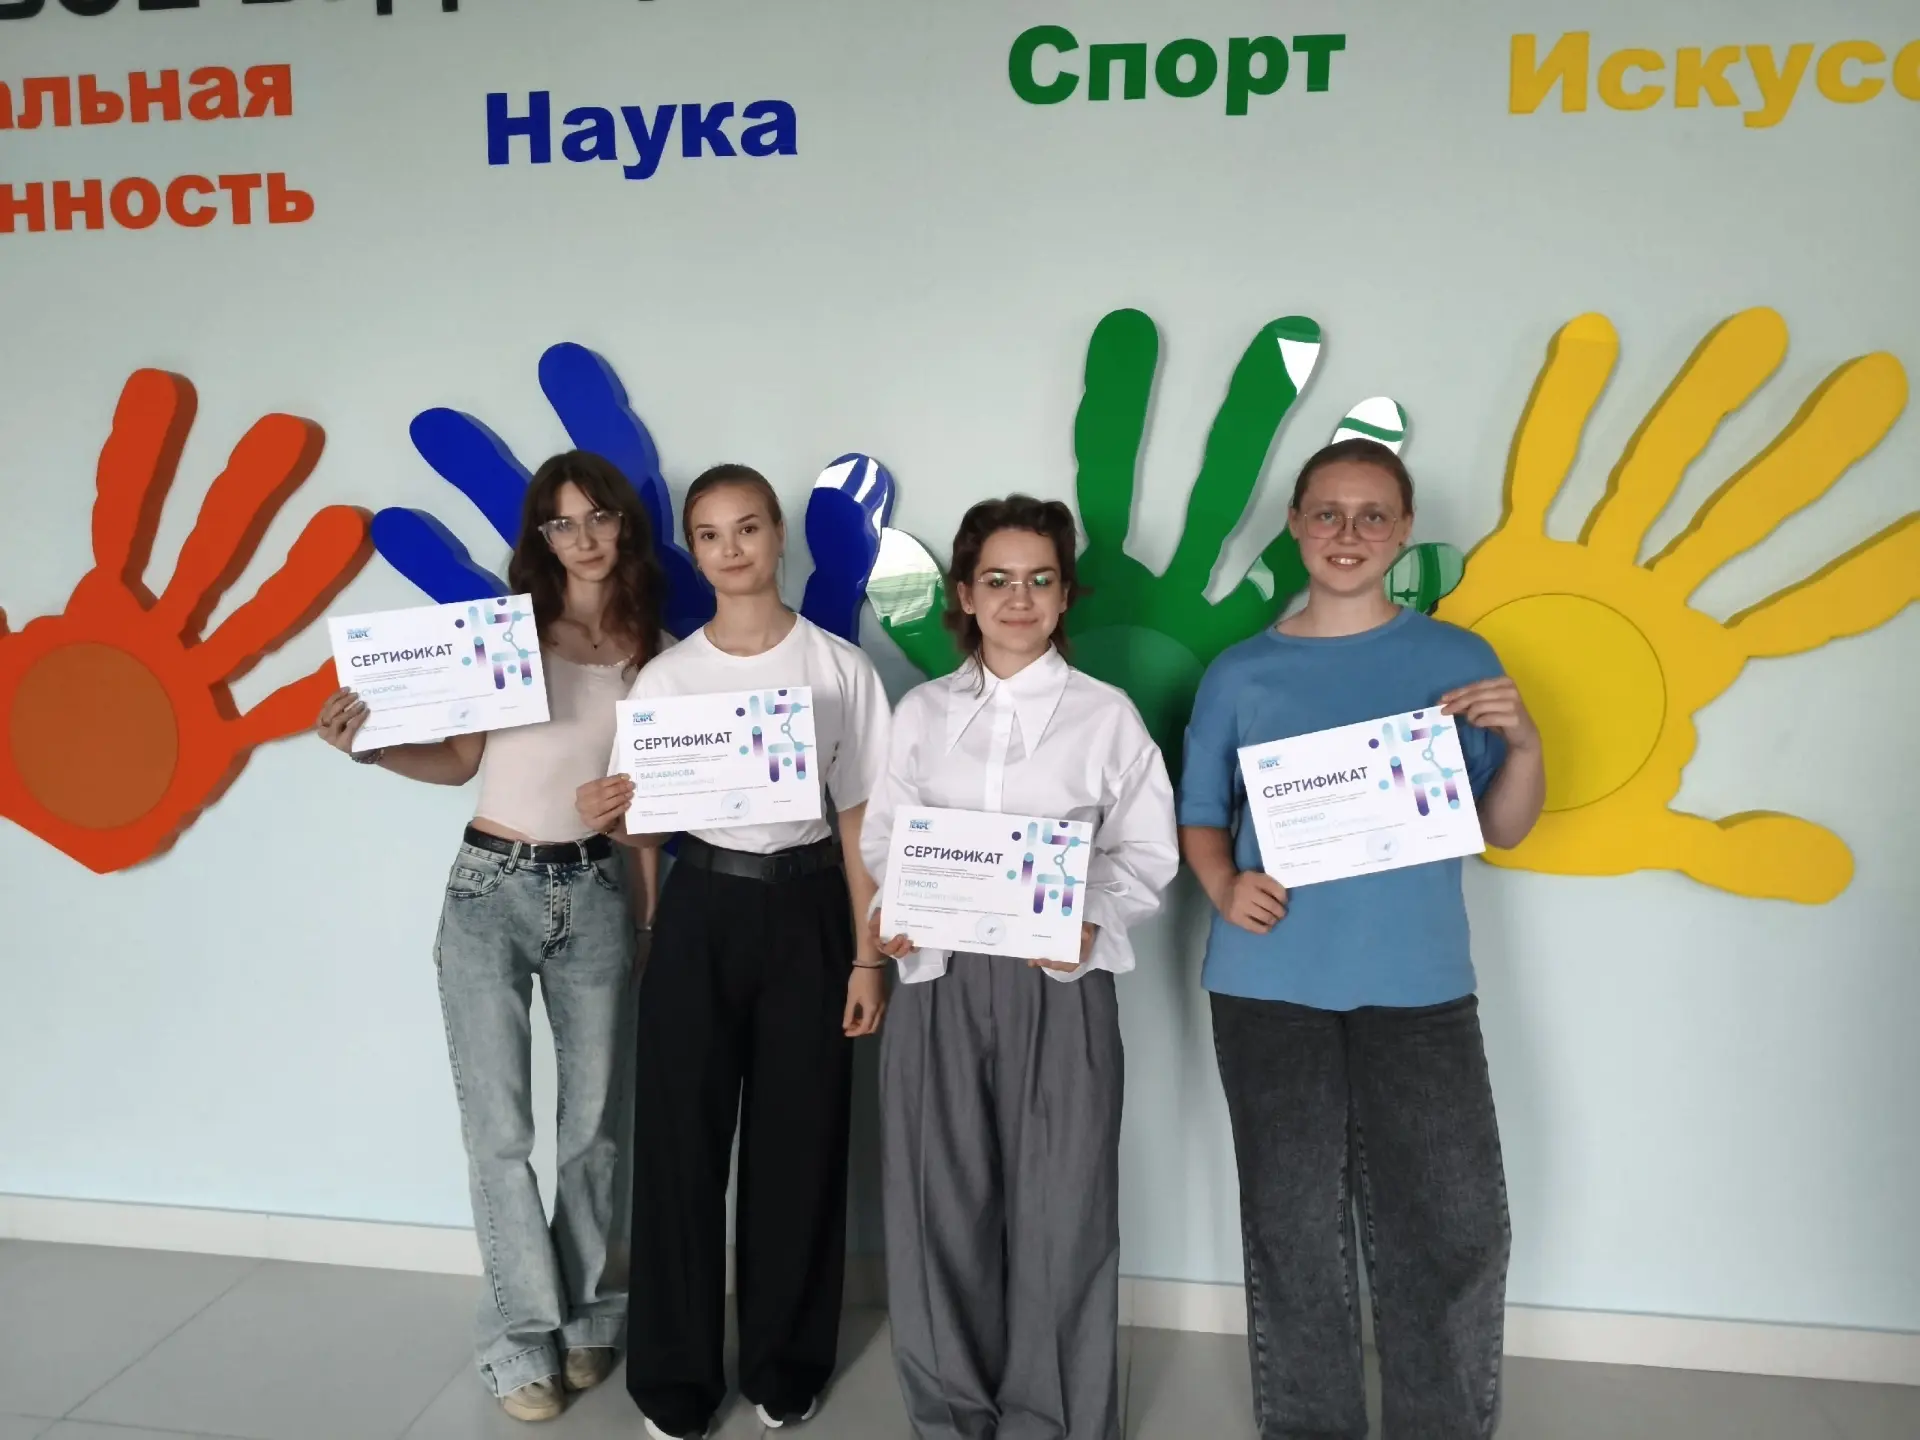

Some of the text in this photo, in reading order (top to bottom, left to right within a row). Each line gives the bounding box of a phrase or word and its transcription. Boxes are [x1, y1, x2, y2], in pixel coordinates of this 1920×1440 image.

[1008, 25, 1346, 116] Спорт
[0, 63, 294, 130] льная
[486, 90, 799, 181] Наука
[0, 172, 315, 234] нность
[350, 643, 453, 668] СЕРТИФИКАТ
[633, 731, 733, 751] СЕРТИФИКАТ
[1262, 766, 1368, 799] СЕРТИФИКАТ
[903, 845, 1004, 865] СЕРТИФИКАТ
